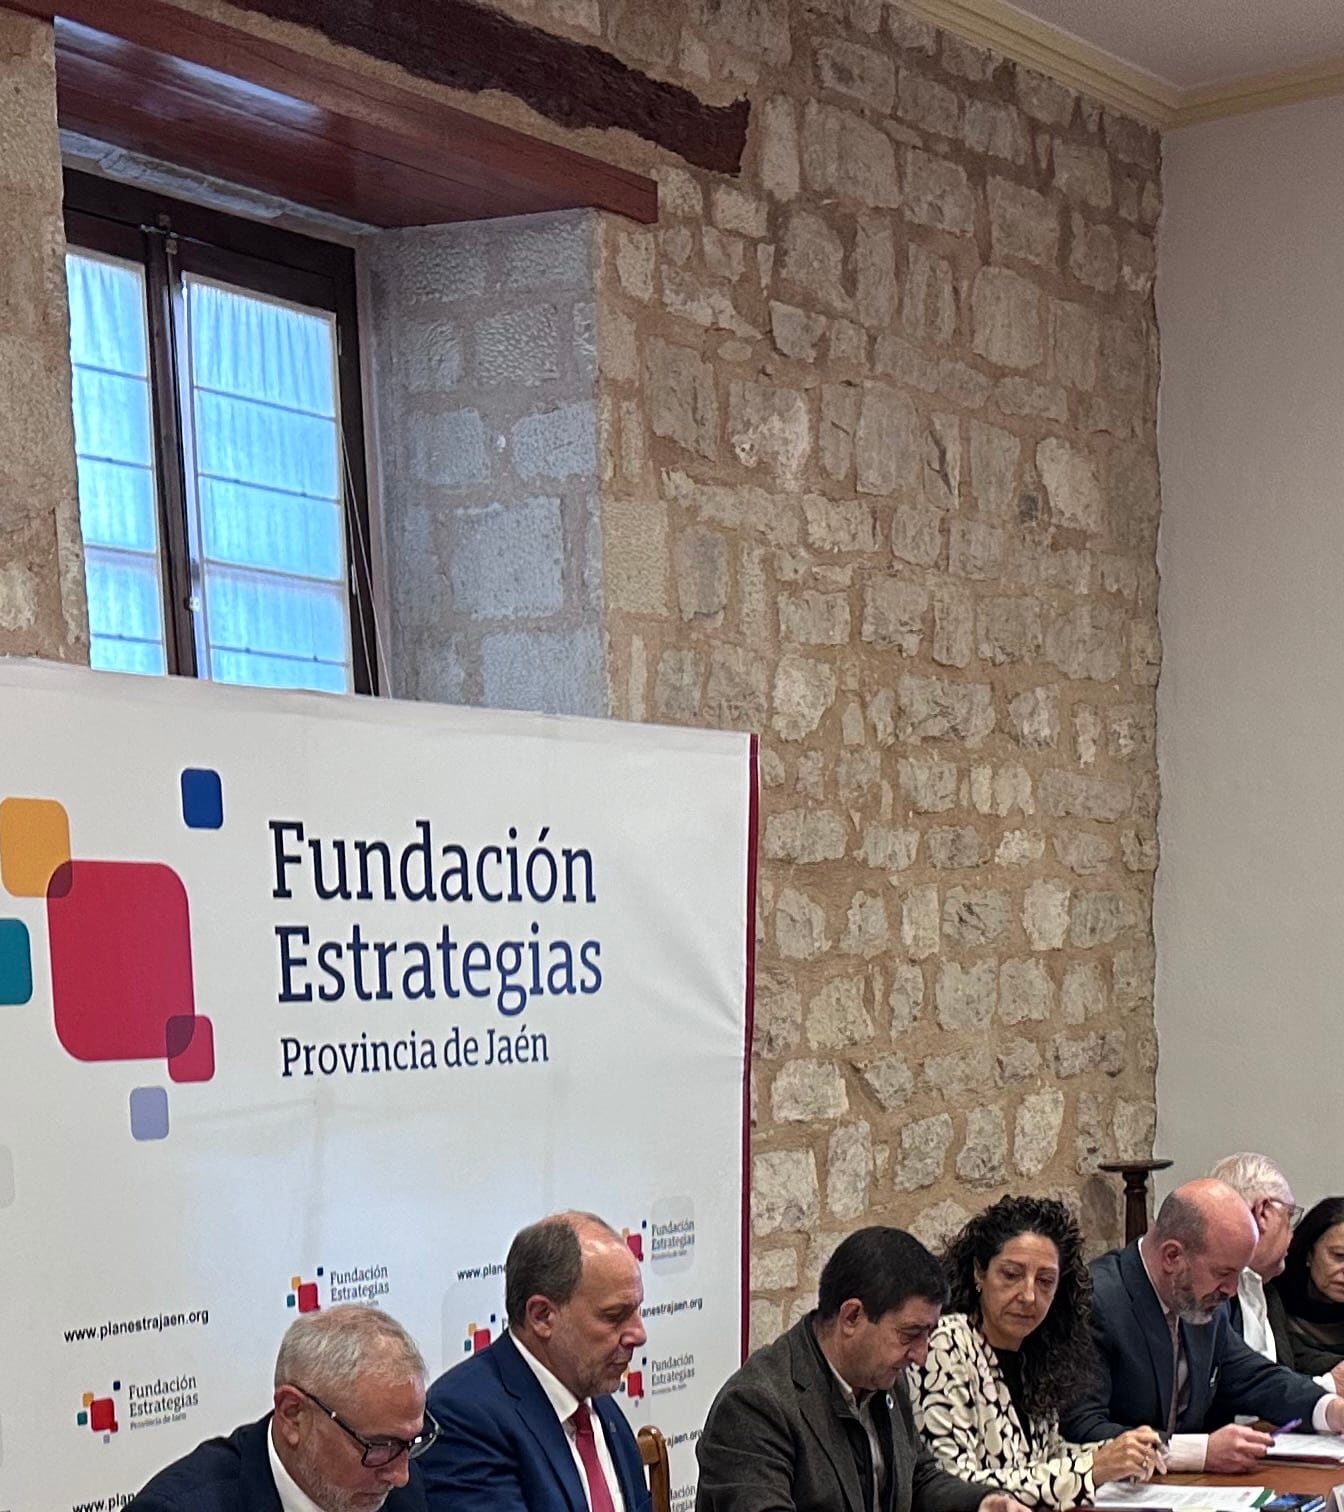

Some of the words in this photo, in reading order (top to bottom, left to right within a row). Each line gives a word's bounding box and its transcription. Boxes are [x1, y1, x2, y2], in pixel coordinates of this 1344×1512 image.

[268, 820, 597, 904] Fundación
[274, 921, 603, 1017] Estrategias
[280, 1030, 437, 1078] Provincia
[443, 1026, 479, 1068] de
[485, 1024, 550, 1066] Jaén
[651, 1217, 695, 1237] Fundación
[651, 1233, 695, 1251] Estrategias
[330, 1264, 388, 1286] Fundación
[456, 1263, 506, 1280] www.plan
[330, 1281, 390, 1302] Estrategias
[63, 1310, 209, 1343] www.planestrajaen.org
[651, 1353, 695, 1373] Fundación
[128, 1374, 197, 1401] Fundación
[651, 1366, 695, 1387] Estrategias
[129, 1392, 199, 1418] Estrategias
